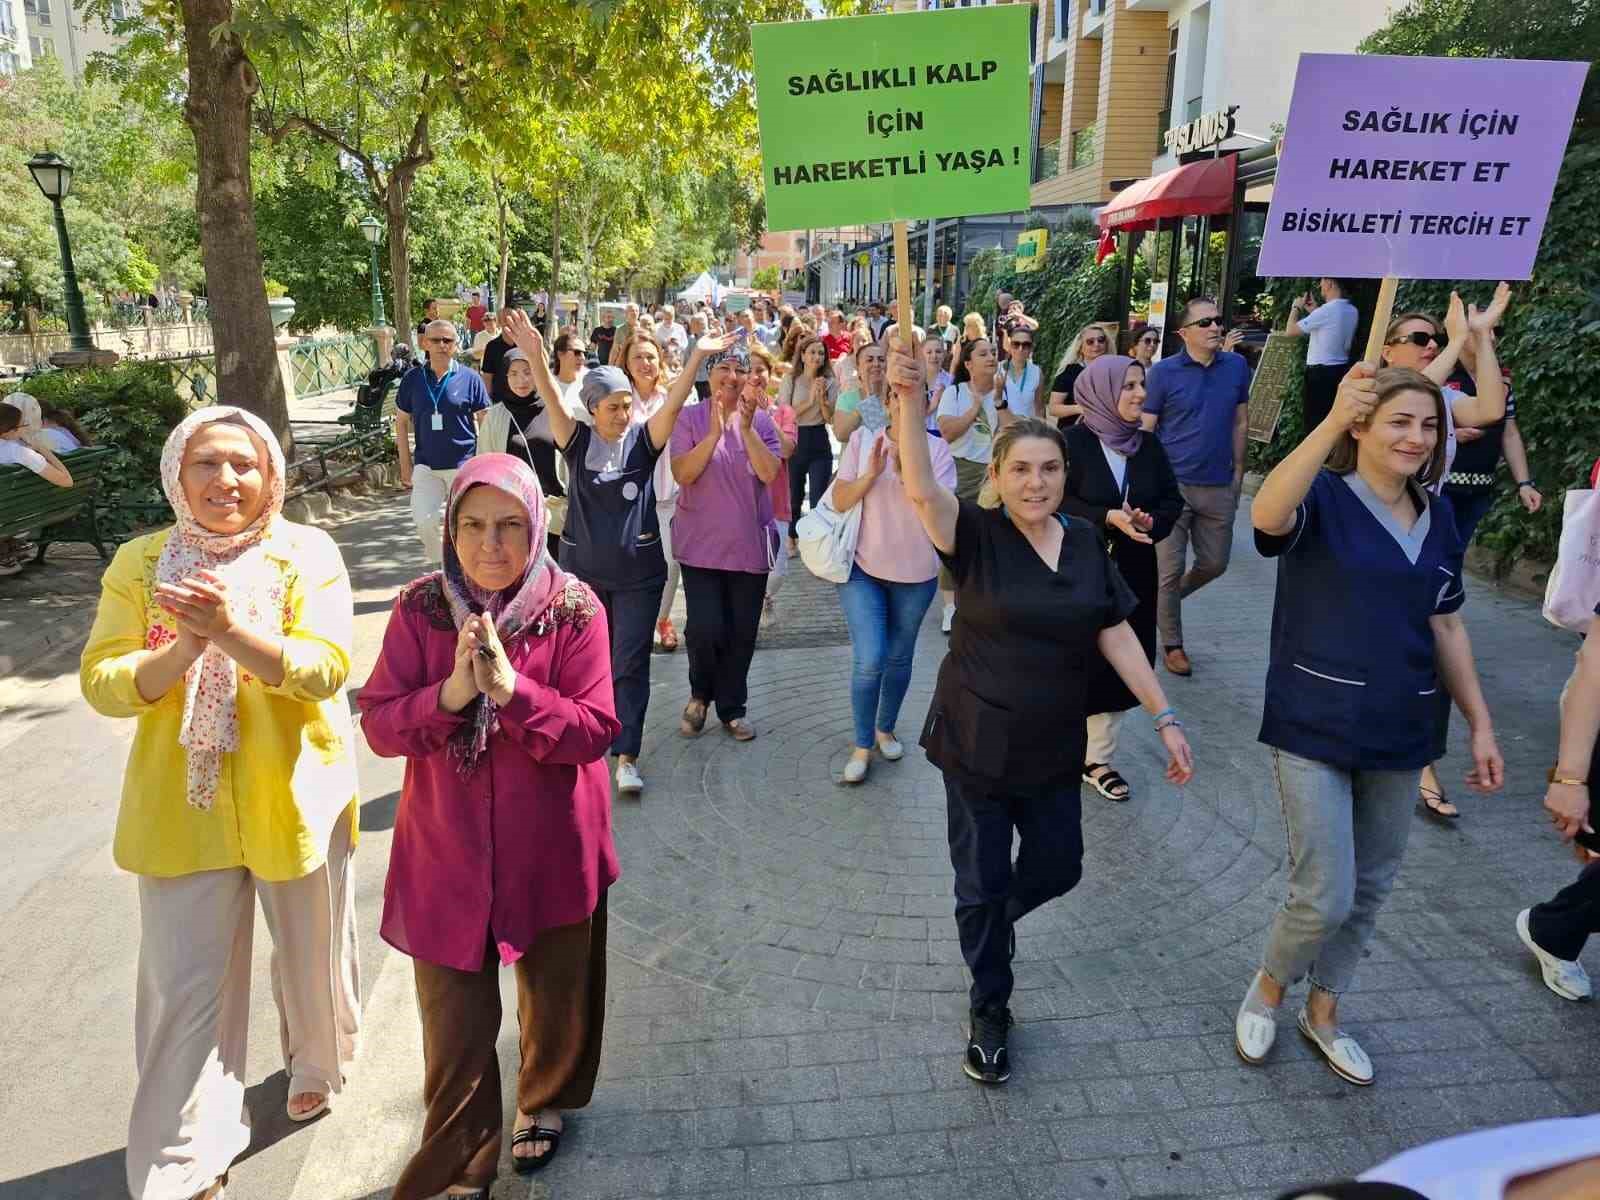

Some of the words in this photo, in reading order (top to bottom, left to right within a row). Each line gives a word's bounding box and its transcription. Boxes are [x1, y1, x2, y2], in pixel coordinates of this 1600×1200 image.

[787, 65, 917, 97] SAĞLIKLI
[925, 60, 998, 86] KALP
[867, 107, 924, 139] İÇİN
[1342, 106, 1452, 134] SAĞLIK
[1458, 108, 1519, 141] İÇİN
[773, 149, 927, 186] HAREKETLİ
[935, 148, 1005, 175] YAŞA
[1012, 145, 1020, 166] !
[1328, 158, 1467, 182] HAREKET
[1472, 161, 1511, 183] ET
[1281, 207, 1402, 235] BİSİKLETİ
[1409, 211, 1495, 236] TERCİH
[1498, 216, 1531, 236] ET
